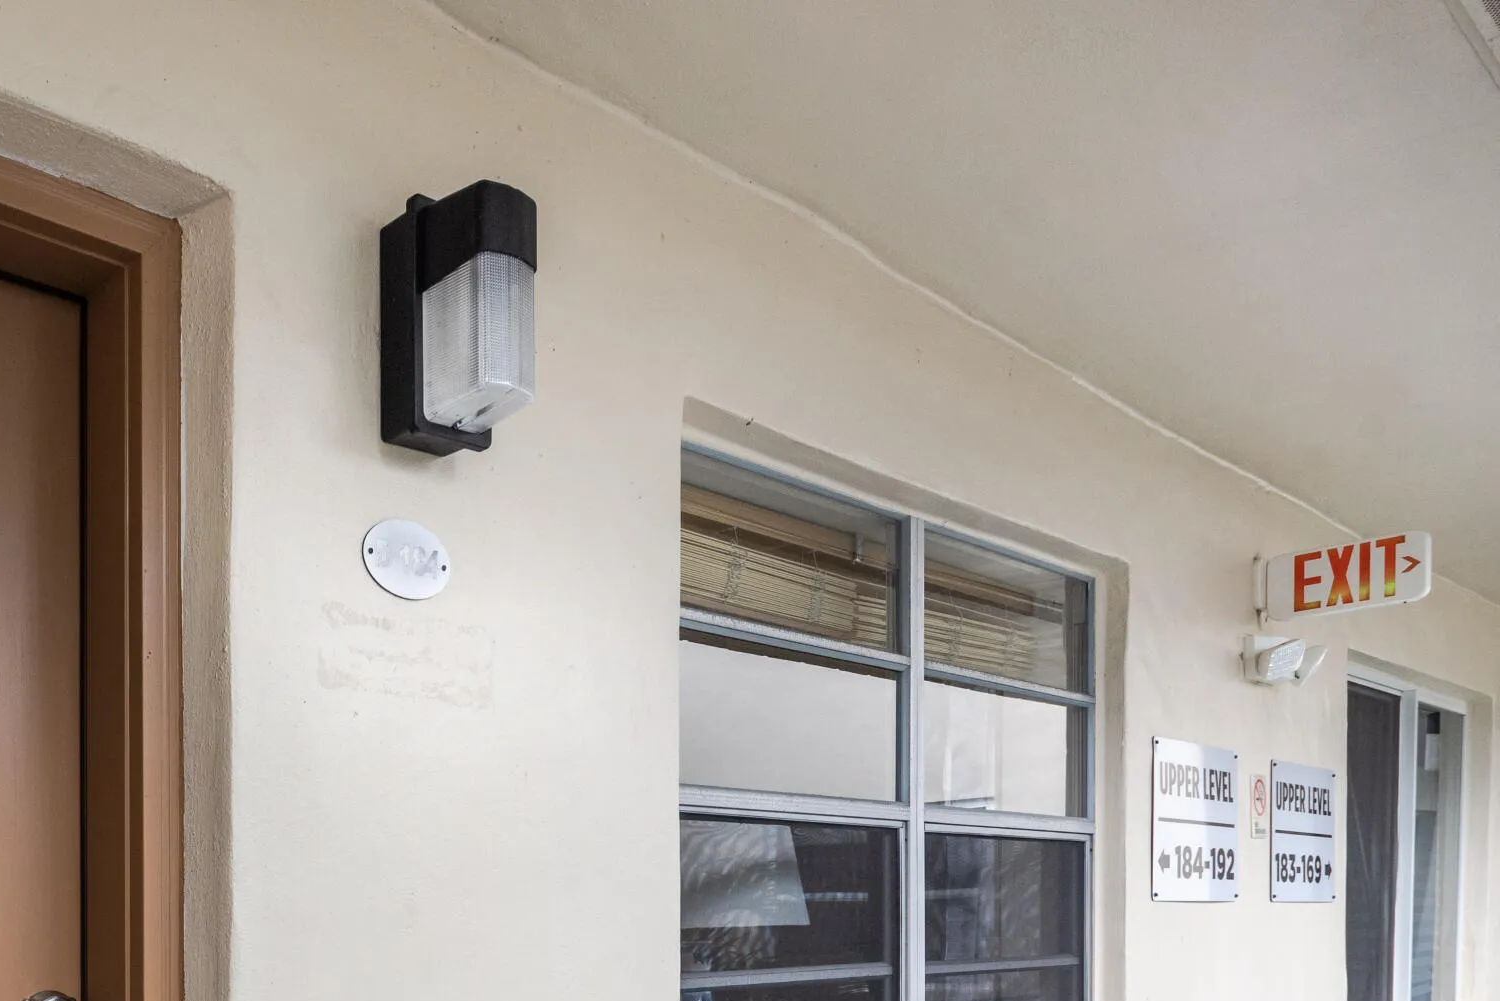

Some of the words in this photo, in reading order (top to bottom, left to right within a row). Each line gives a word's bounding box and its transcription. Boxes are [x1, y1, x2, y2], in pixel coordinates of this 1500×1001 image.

[1293, 535, 1405, 612] EXIT
[1159, 761, 1200, 799] UPPER
[1203, 768, 1234, 803] LEVEL
[1275, 781, 1306, 813] UPPER
[1308, 786, 1332, 817] LEVEL
[1174, 845, 1235, 880] 184-192
[1275, 853, 1322, 884] 183-169
